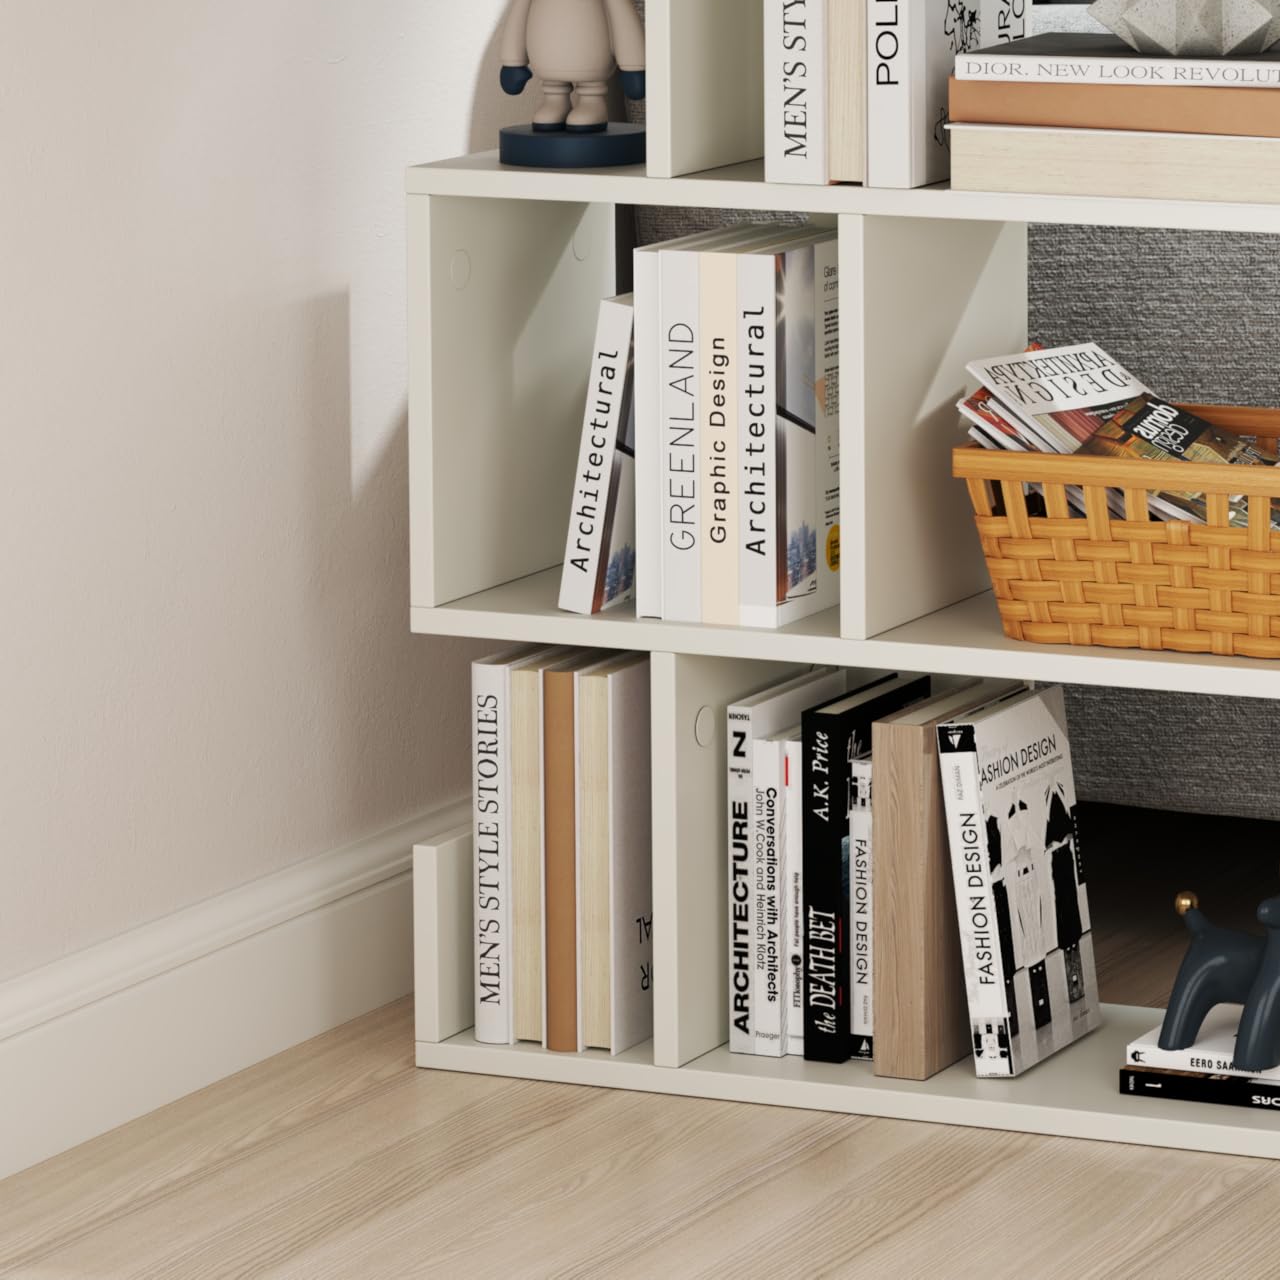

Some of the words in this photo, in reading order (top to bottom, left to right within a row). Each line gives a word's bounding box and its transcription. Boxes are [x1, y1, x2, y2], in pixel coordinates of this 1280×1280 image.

[1037, 62, 1091, 77] NEW
[1099, 64, 1166, 80] LOOK
[784, 61, 808, 159] MEN'S
[708, 337, 730, 427] Design
[570, 349, 619, 573] Architectural
[668, 322, 695, 551] GREENLAND
[743, 306, 767, 556] Architectural
[709, 440, 731, 544] Graphic
[476, 693, 499, 815] STORIES
[811, 730, 829, 775] Price
[1021, 734, 1057, 766] DESIGN
[755, 788, 765, 816] John
[766, 787, 778, 891] Conversations
[478, 822, 500, 911] STYLE
[756, 872, 766, 891] and
[855, 839, 867, 915] FASHION
[960, 812, 984, 888] DESIGN
[732, 801, 750, 1034] ARCHITECTURE
[756, 894, 766, 940] Heinrich
[766, 895, 778, 925] with
[808, 905, 836, 943] BET
[969, 896, 995, 985] FASHION
[478, 918, 501, 1006] MEN'S
[756, 944, 766, 970] Klotz
[767, 929, 779, 1002] Architects
[808, 943, 836, 1011] DEATH
[856, 921, 868, 985] DESIGN
[814, 1011, 837, 1034] the
[1189, 1057, 1213, 1069] EERO
